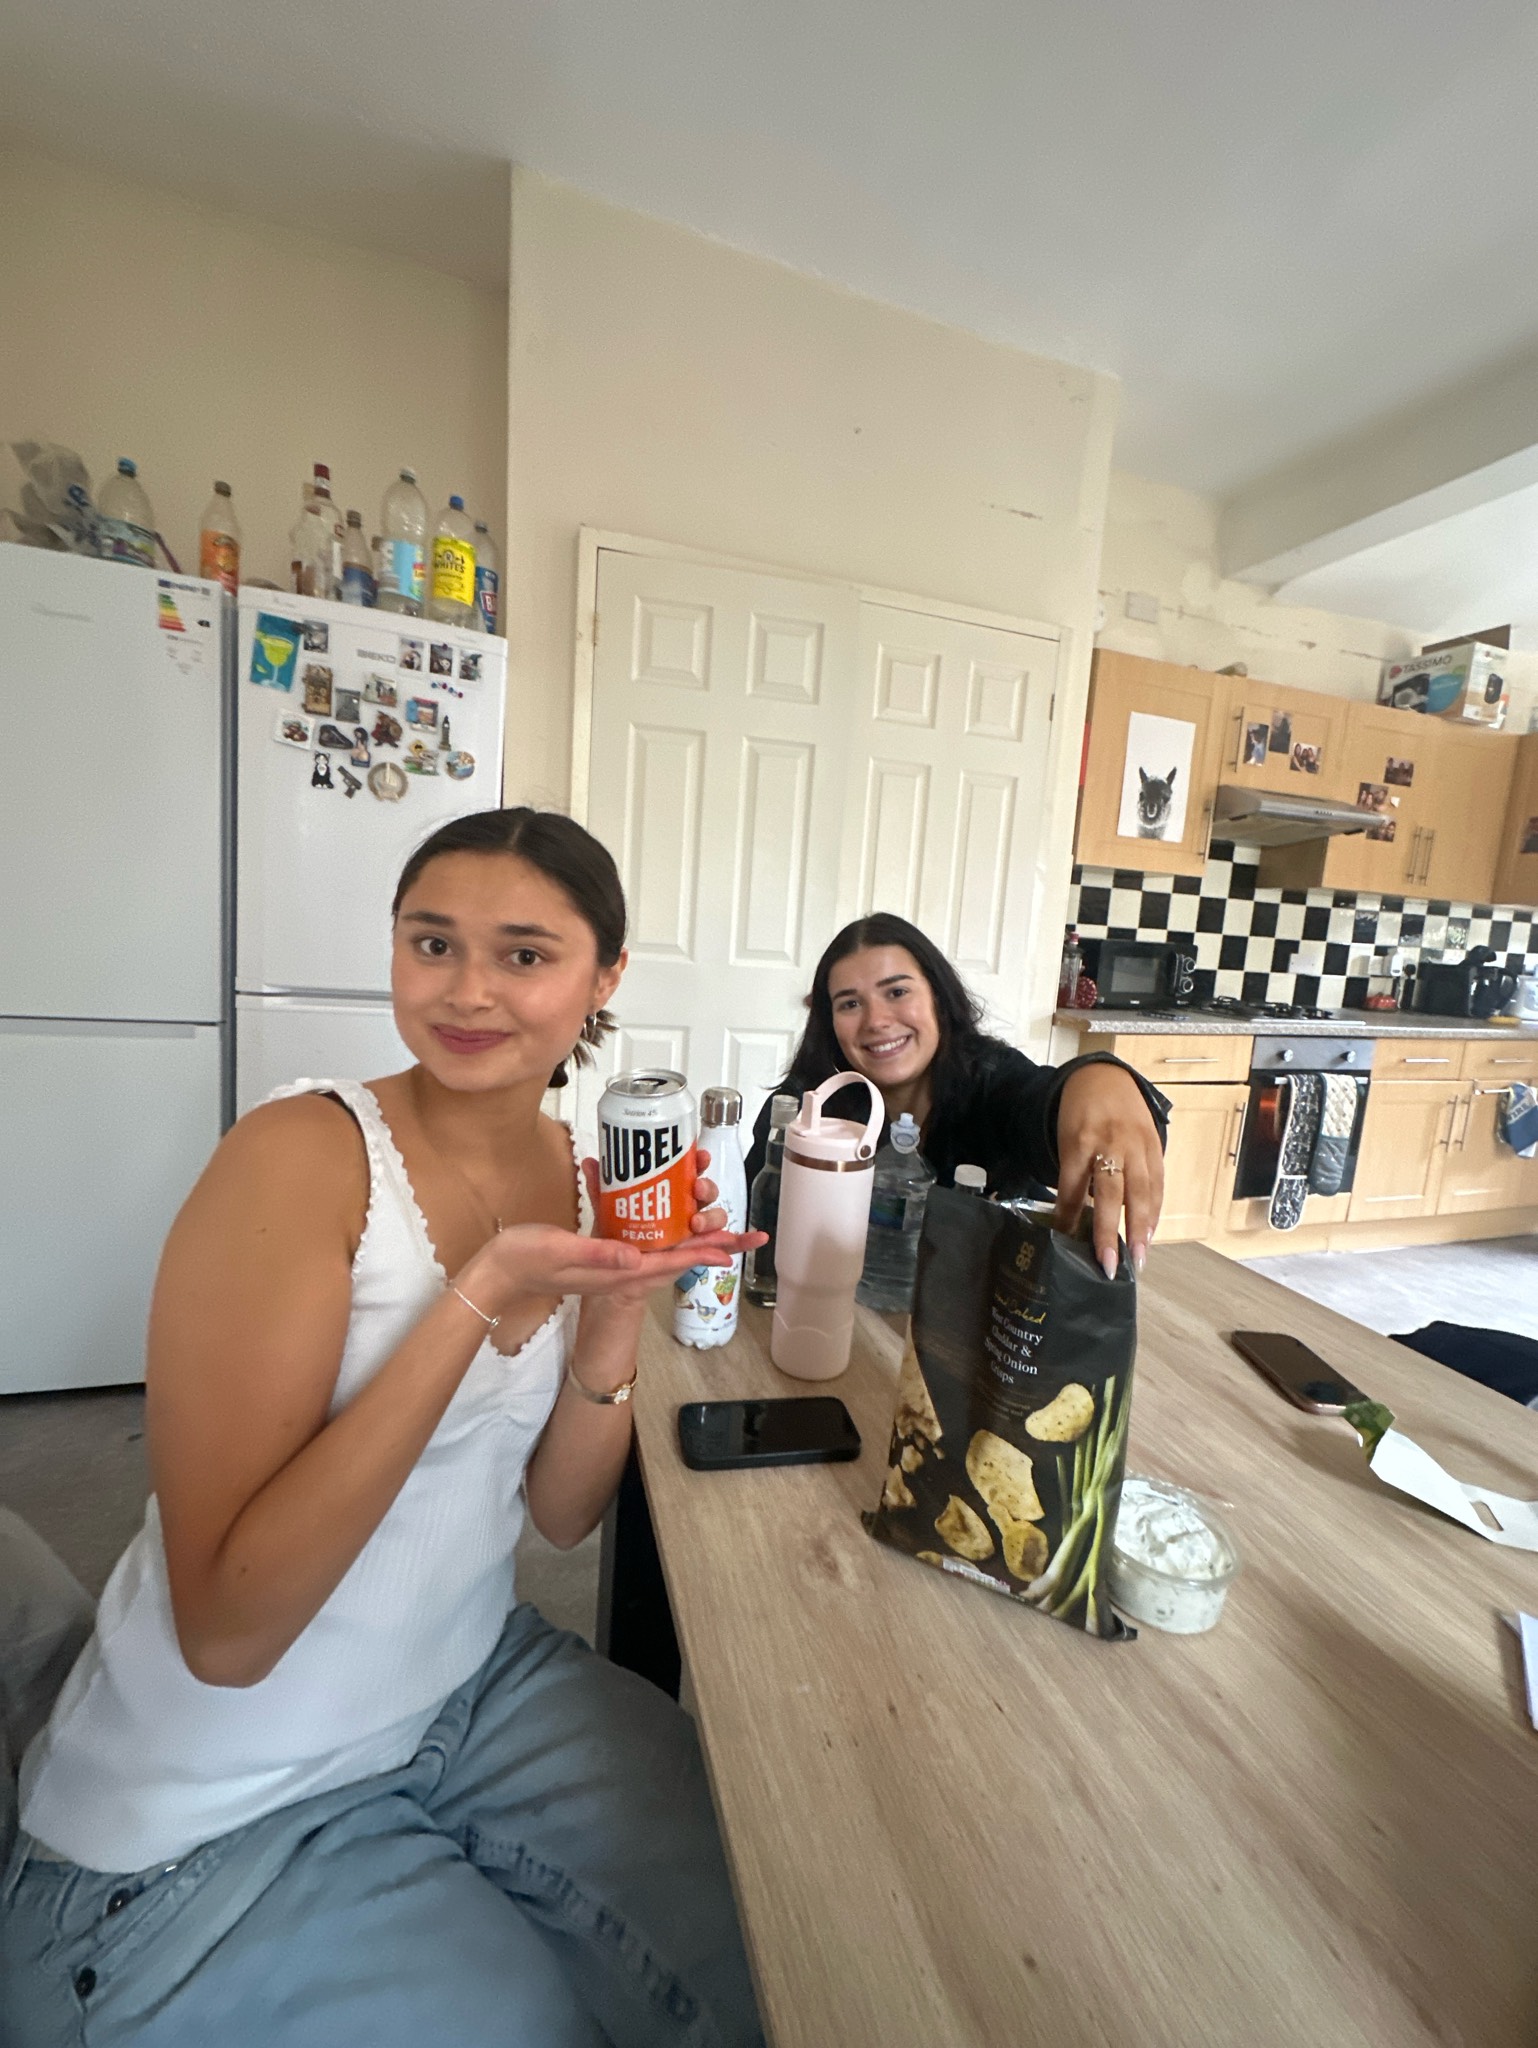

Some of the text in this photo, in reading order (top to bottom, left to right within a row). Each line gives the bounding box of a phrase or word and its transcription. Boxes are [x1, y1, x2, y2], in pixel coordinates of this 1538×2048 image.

[433, 561, 465, 573] WHITES
[1403, 655, 1452, 673] TASSIMO
[601, 1121, 683, 1186] JUBEL
[615, 1178, 671, 1221] BEER
[622, 1229, 664, 1240] PEACH
[1003, 1317, 1043, 1346] Country
[1021, 1345, 1032, 1358] &
[1003, 1353, 1038, 1375] Onion
